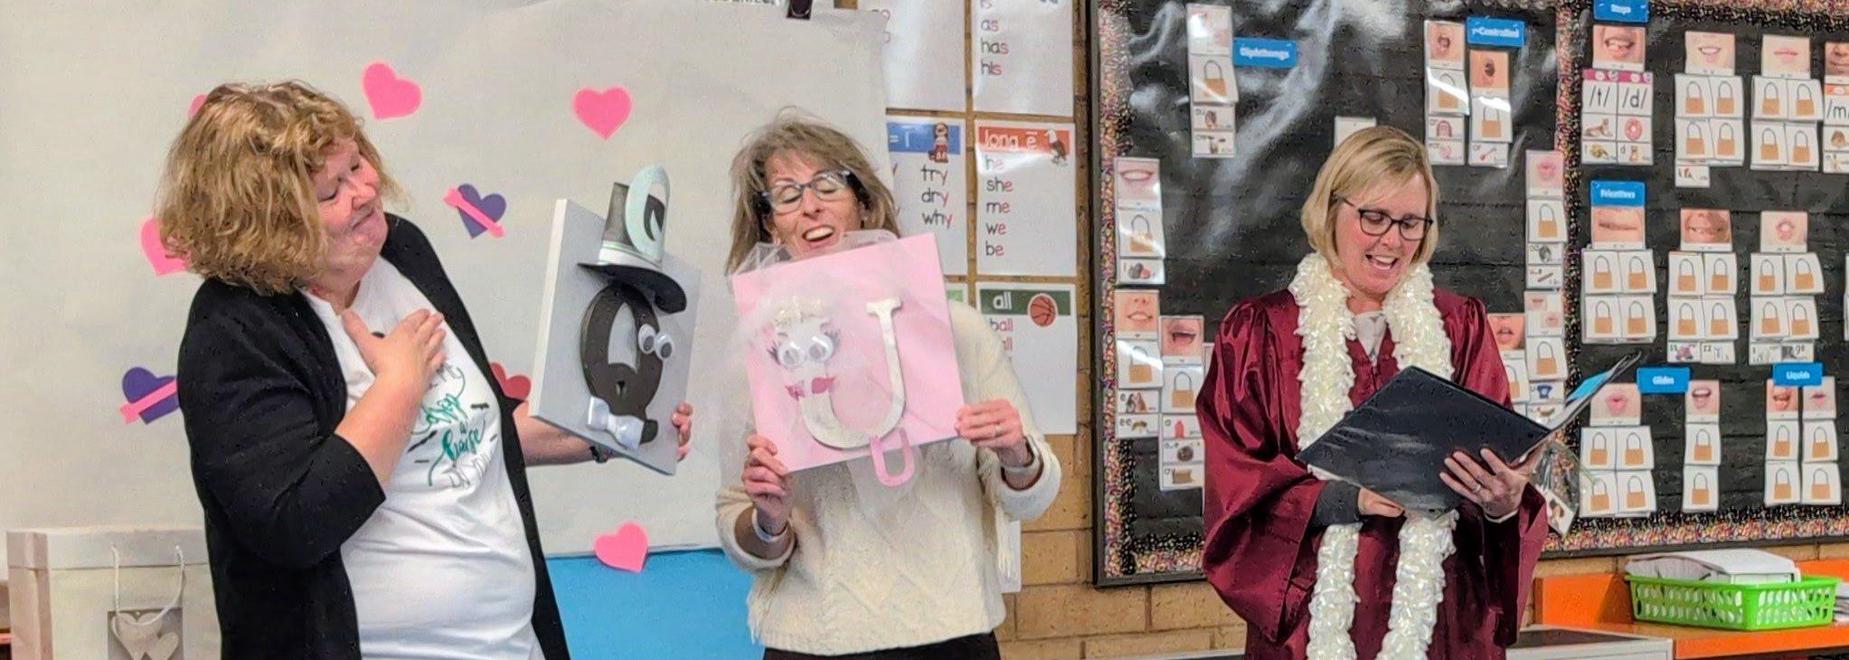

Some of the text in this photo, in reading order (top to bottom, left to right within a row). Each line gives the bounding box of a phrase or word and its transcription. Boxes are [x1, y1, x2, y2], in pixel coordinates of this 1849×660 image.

[980, 19, 999, 33] as
[980, 37, 1009, 55] has
[980, 59, 1002, 76] his
[1622, 86, 1648, 110] /d/
[984, 129, 1020, 151] long
[920, 164, 949, 187] try
[985, 176, 1014, 193] she
[920, 187, 950, 207] dry
[985, 201, 1011, 214] me
[921, 210, 954, 230] why
[985, 222, 1008, 236] we
[985, 240, 1005, 257] be
[993, 290, 1013, 311] all
[580, 280, 659, 446] Q
[772, 297, 906, 449] U
